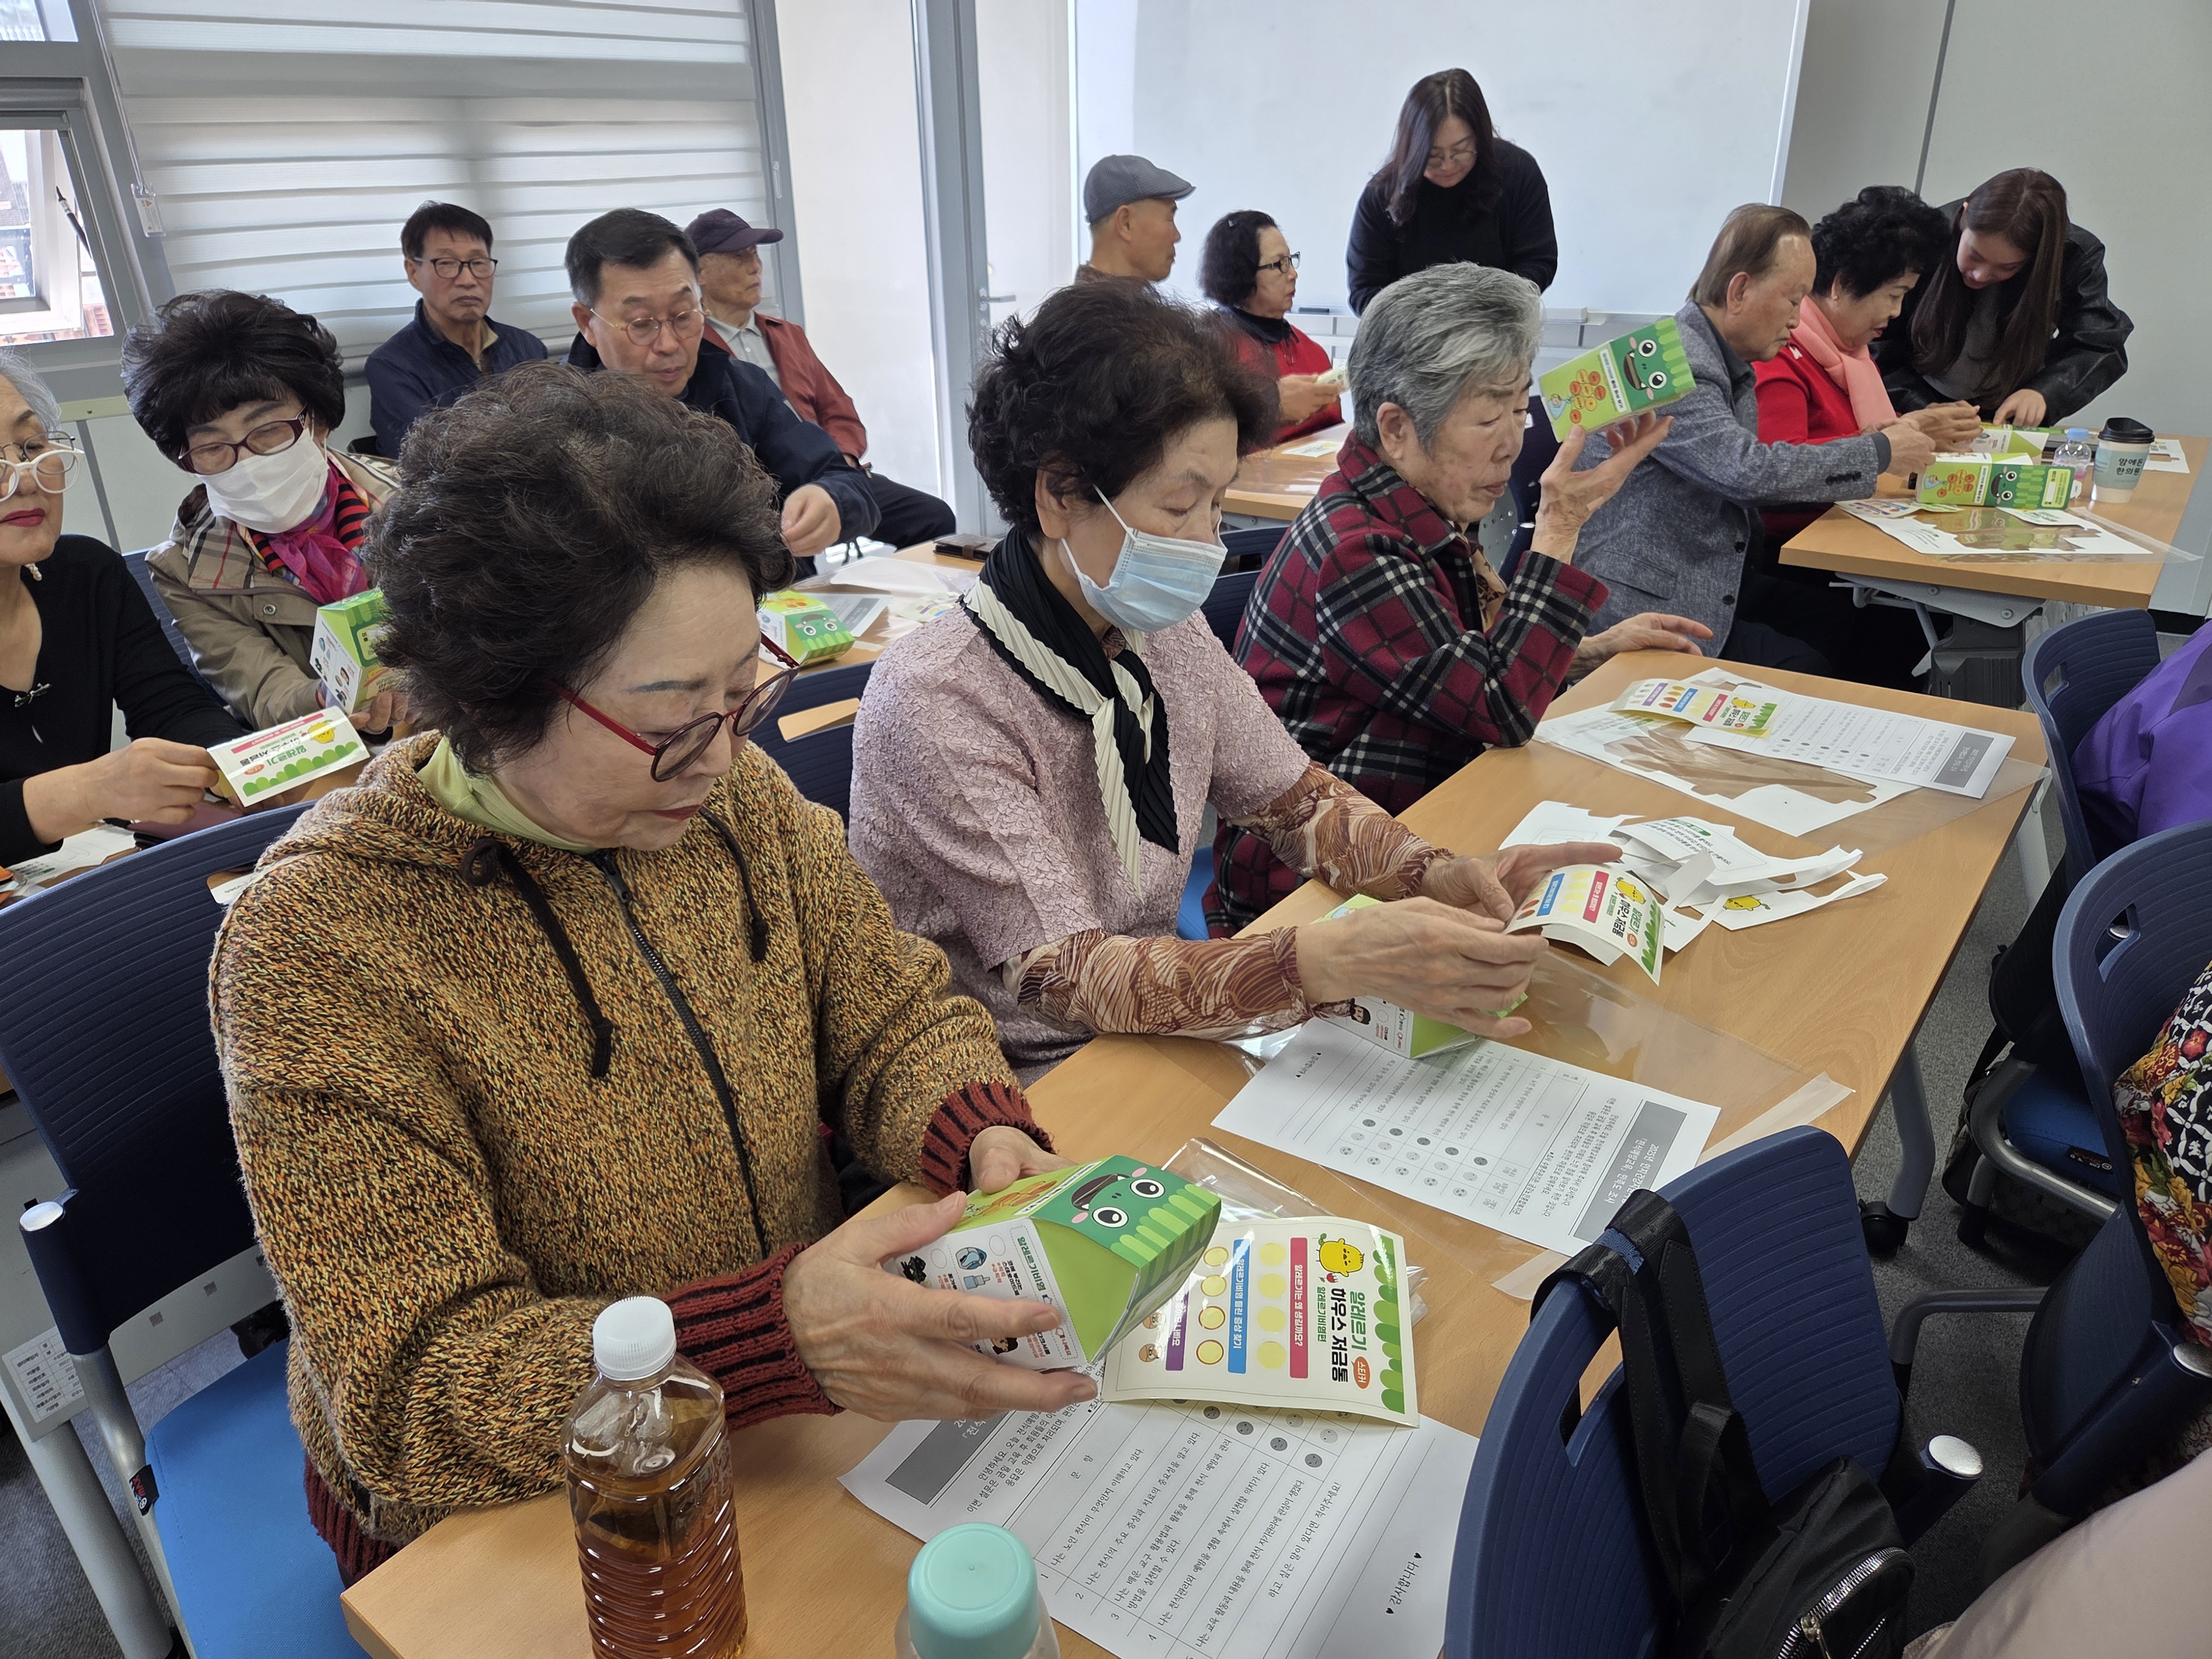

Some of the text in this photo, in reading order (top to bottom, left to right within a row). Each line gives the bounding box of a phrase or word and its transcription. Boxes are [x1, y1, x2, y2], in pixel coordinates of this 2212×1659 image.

[266, 745, 307, 766] 알레르기
[1612, 899, 1631, 938] 하우스 저금통
[1629, 907, 1642, 935] 알레르기
[1297, 1056, 1319, 1074] 감사합니다
[1611, 1172, 1628, 1191] 만족도
[1644, 1144, 1660, 1162] 2025년
[1604, 1190, 1619, 1204] 조사
[1017, 1236, 1046, 1292] 알레르기비염
[1233, 1257, 1245, 1349] 알레르기비염 틀린 증상 찾기
[1294, 1264, 1303, 1347] 알레르기는 왜 생길까요?
[1317, 1286, 1327, 1343] 알레르기비염편
[1349, 1291, 1368, 1351] 알레르기
[1331, 1288, 1348, 1383] 하우스 저금통
[1357, 1360, 1366, 1384] 스티커
[967, 1499, 983, 1512] 이번
[979, 1479, 999, 1499] 설문은
[995, 1464, 1011, 1479] 금일
[1007, 1451, 1023, 1465] 교육
[1019, 1443, 1029, 1451] 후
[1026, 1419, 1050, 1443] 회원들의
[1005, 1436, 1020, 1449] 오늘
[1005, 1468, 1025, 1487] 응답은
[1021, 1443, 1045, 1466] 익명으로
[1041, 1418, 1067, 1442] 처리되며,
[1069, 1454, 1093, 1481] 문 항
[1050, 1448, 1144, 1566] 나는 노인 천식이 무엇인지 이해하고 있다.
[1085, 1432, 1201, 1585] 나는 천식의 주요 증상과 치료의 중요성을 알고 있다.
[1114, 1437, 1233, 1602] 나는 배운 교구 활용법과 활동을 통해 천식 예방과 관리
[1157, 1462, 1271, 1626] 나는 천식관리와 예방을 생활 속에서 실천할 의지가 있다.
[1195, 1480, 1305, 1647] 나는 교육 활동과 내용을 통해 천식 자기관리에 관심이 생겼다.
[1267, 1481, 1342, 1598] 하고 싶은 말이 있다면 적어주세요!
[1126, 1588, 1147, 1609] 방법을
[1144, 1564, 1163, 1586] 실천할
[1165, 1540, 1181, 1554] 있다.
[1389, 1561, 1420, 1605] 감사합니다
